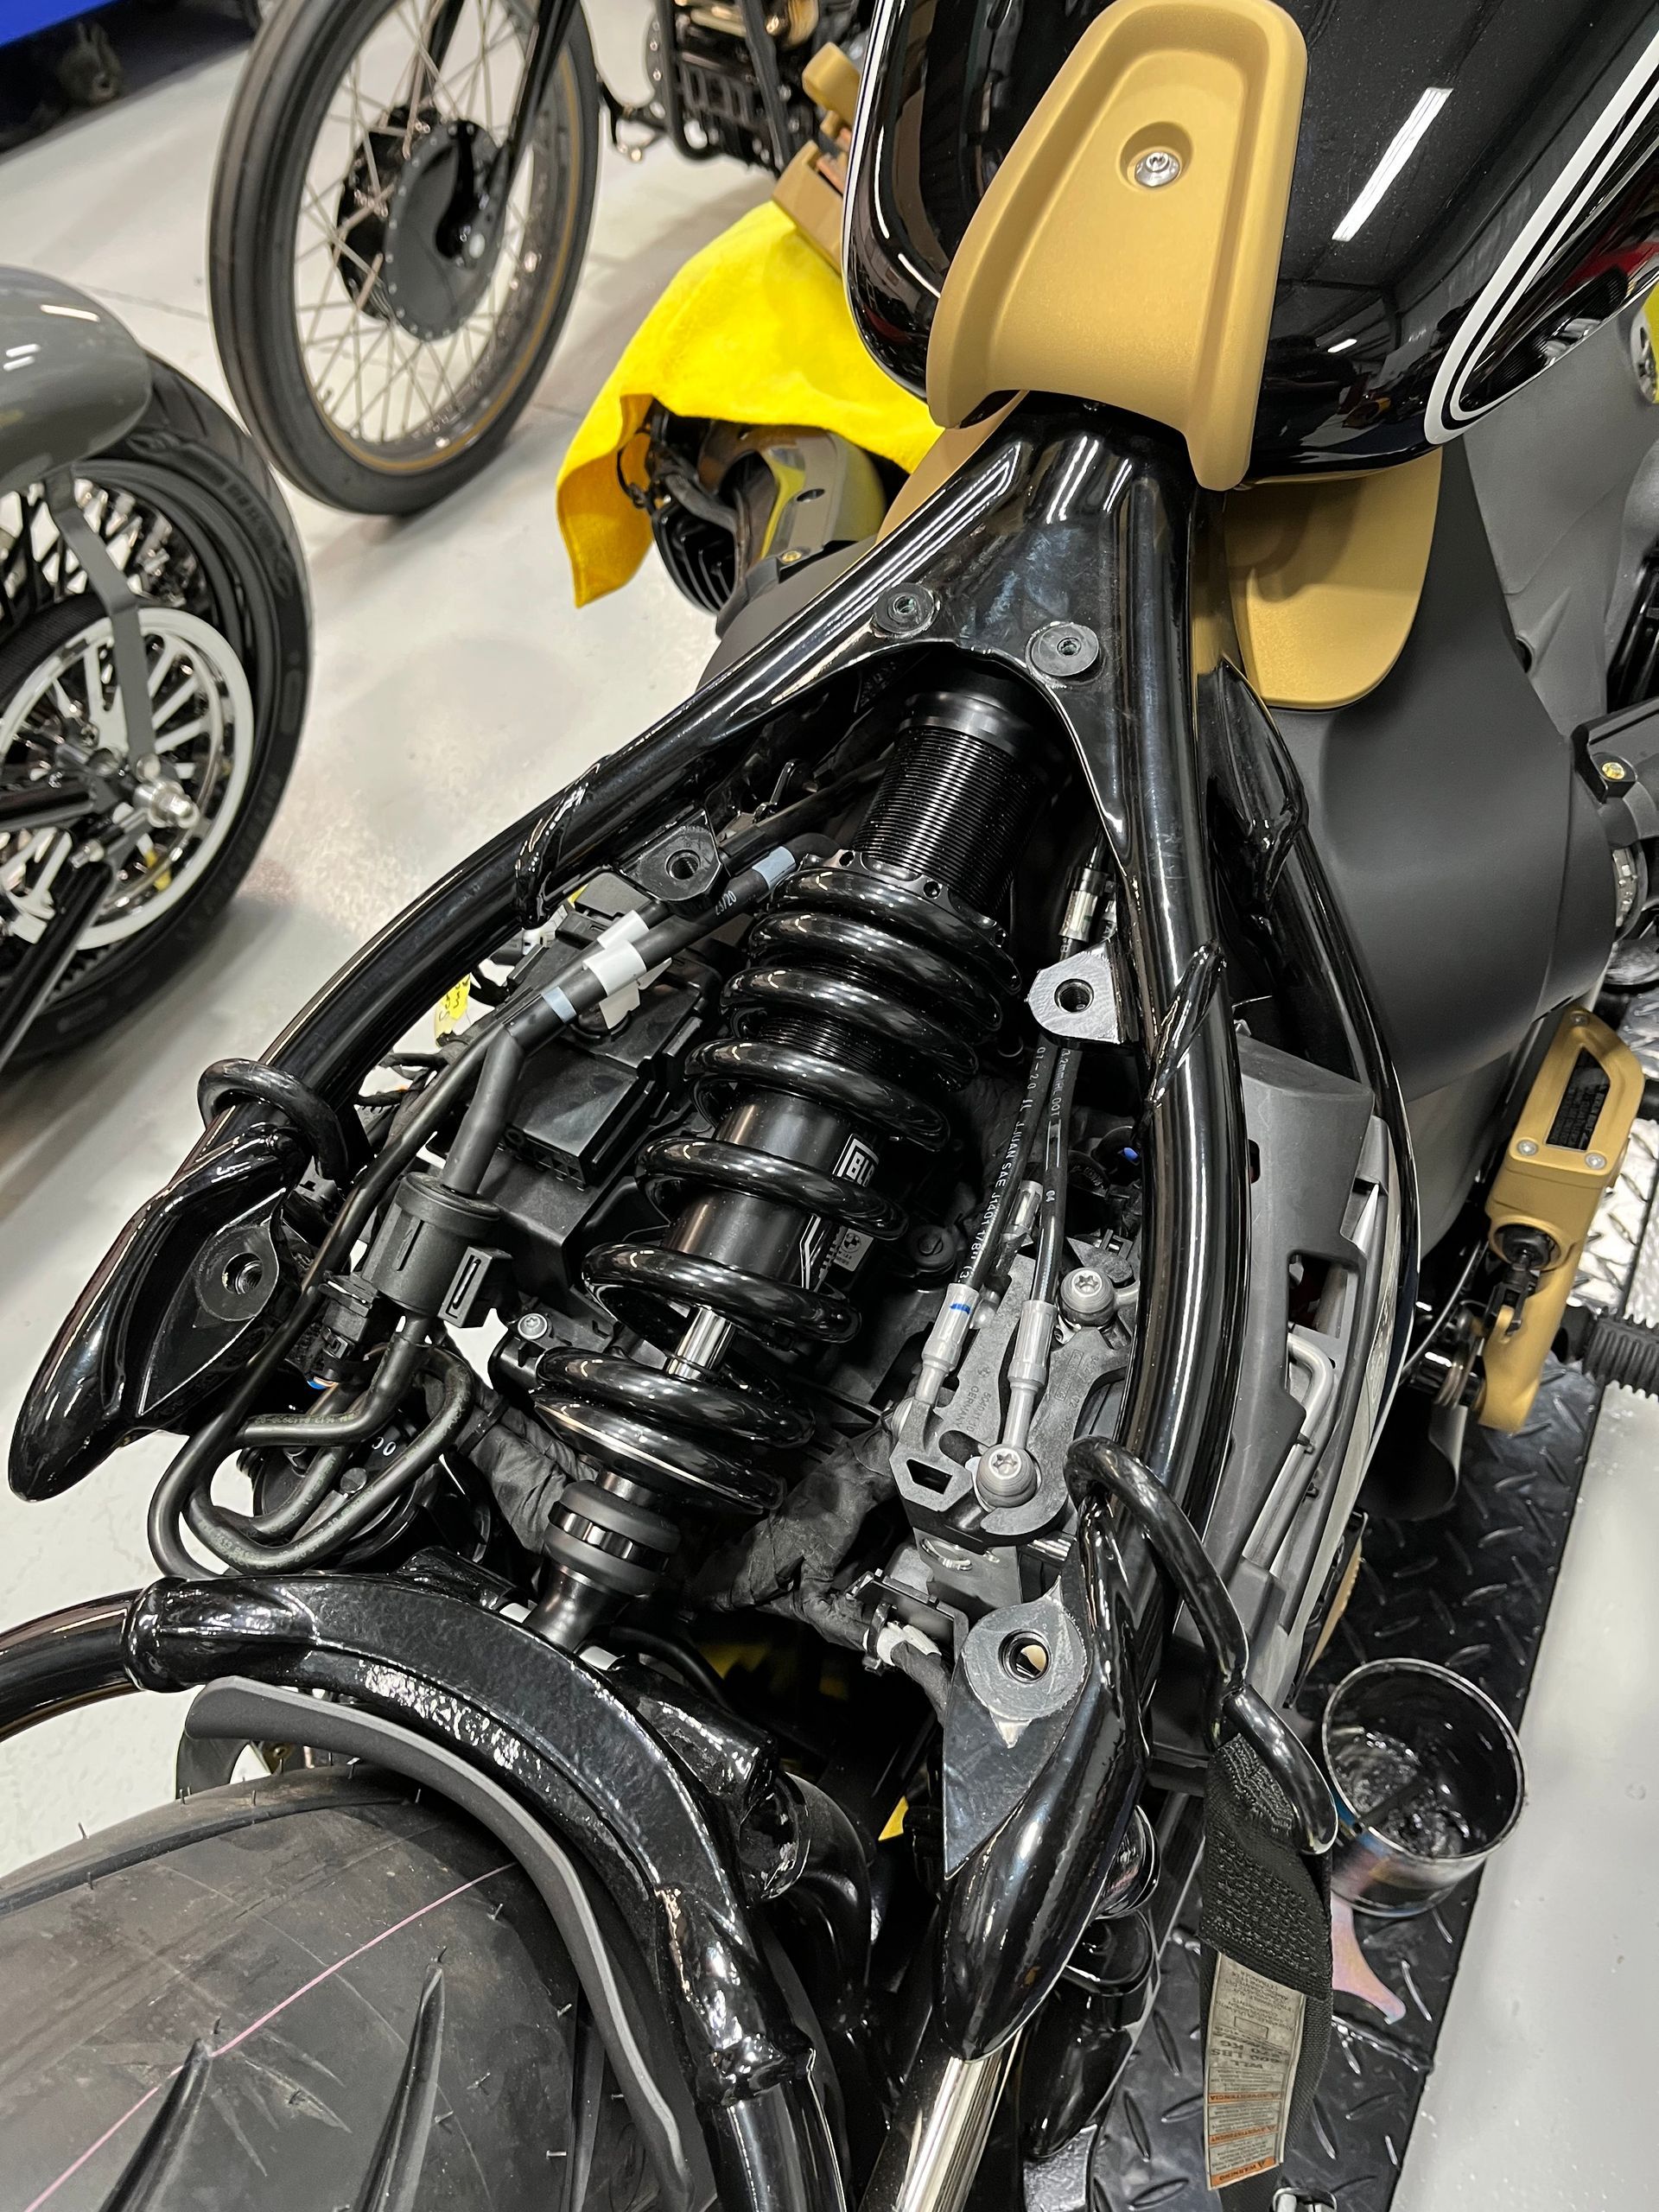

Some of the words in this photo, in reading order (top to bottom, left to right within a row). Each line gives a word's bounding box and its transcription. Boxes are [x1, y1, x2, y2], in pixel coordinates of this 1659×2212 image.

[1005, 1121, 1025, 1160] J.JUAN
[995, 1161, 1014, 1187] SAE
[982, 1192, 1001, 1227] J1401
[954, 1385, 980, 1430] GERMANY
